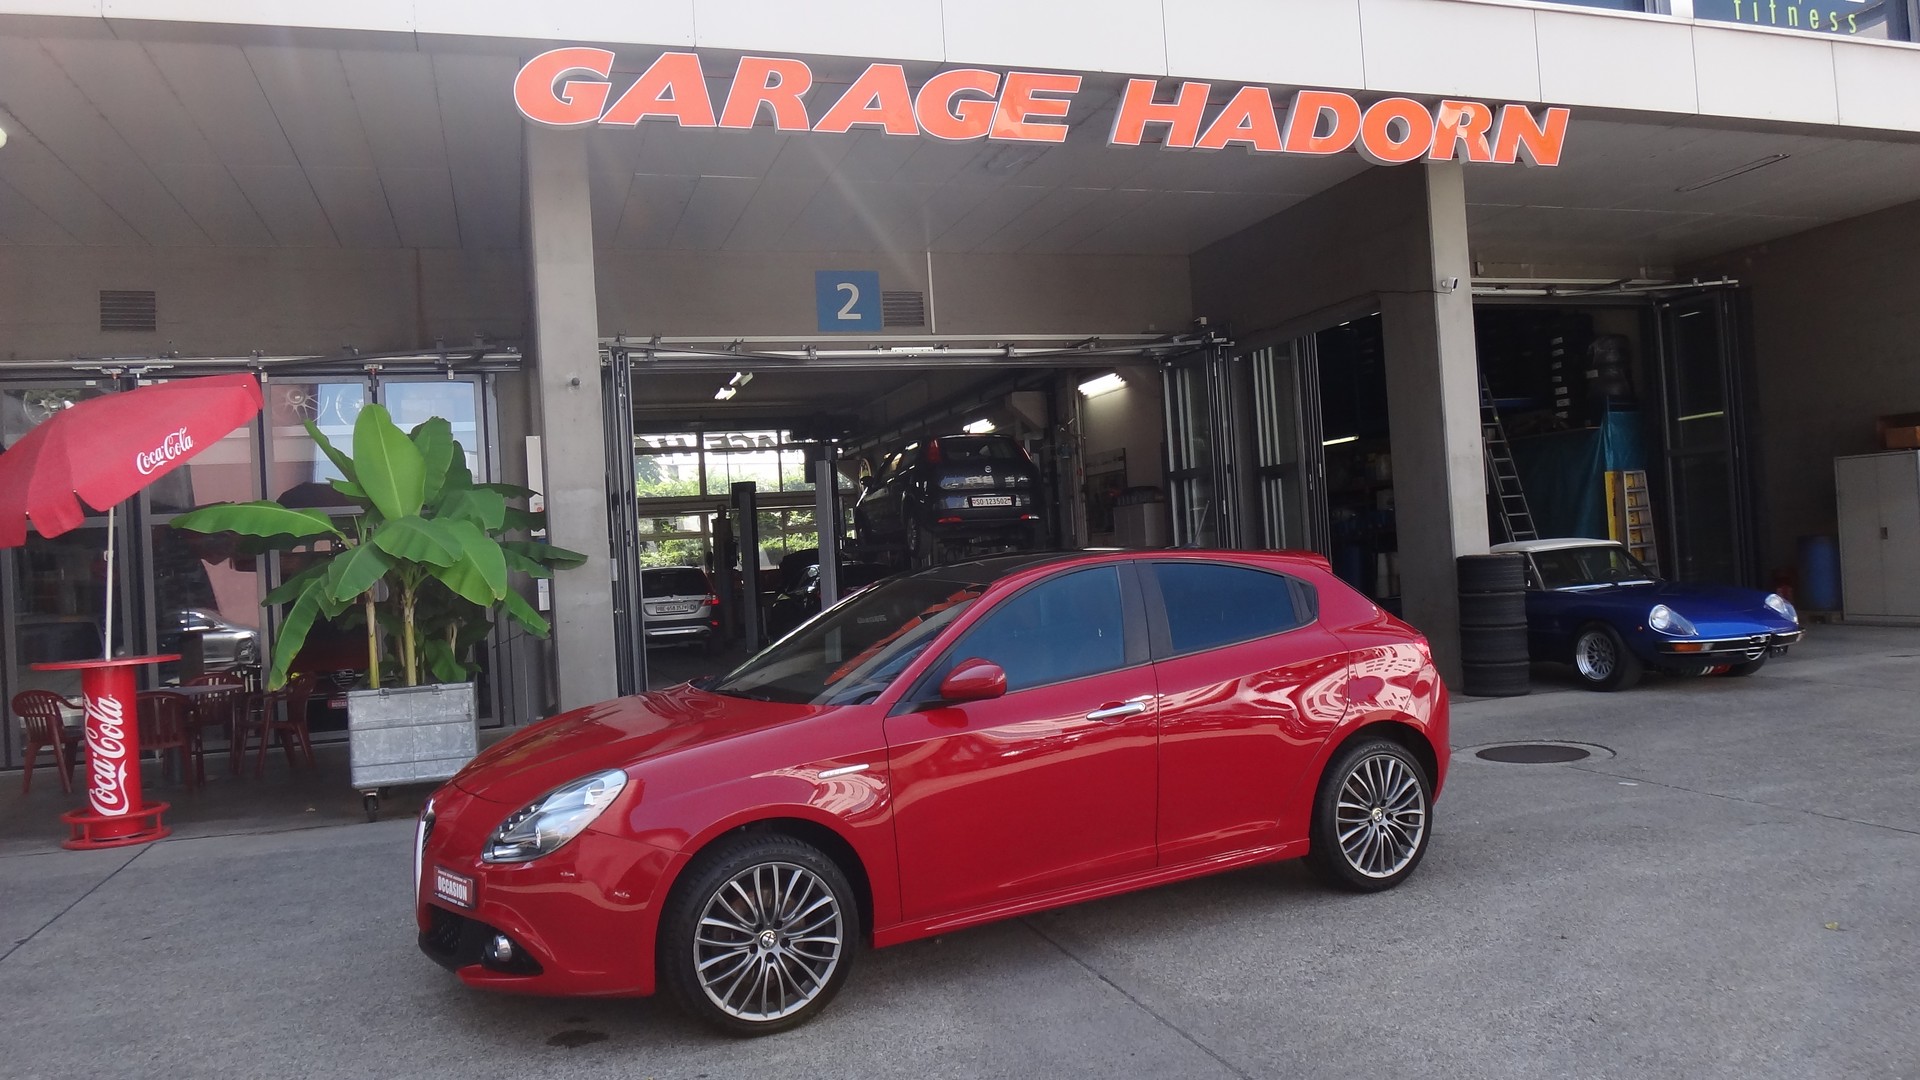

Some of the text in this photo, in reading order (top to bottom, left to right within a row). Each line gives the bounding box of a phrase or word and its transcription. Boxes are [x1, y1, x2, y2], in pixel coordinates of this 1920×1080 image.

[1733, 0, 1857, 34] fitness
[513, 46, 1571, 168] GARAGE HADORN
[836, 282, 862, 320] 2
[136, 426, 194, 475] Coca-Cola
[84, 692, 129, 816] Coca-Cola
[437, 875, 468, 902] OCCASION
